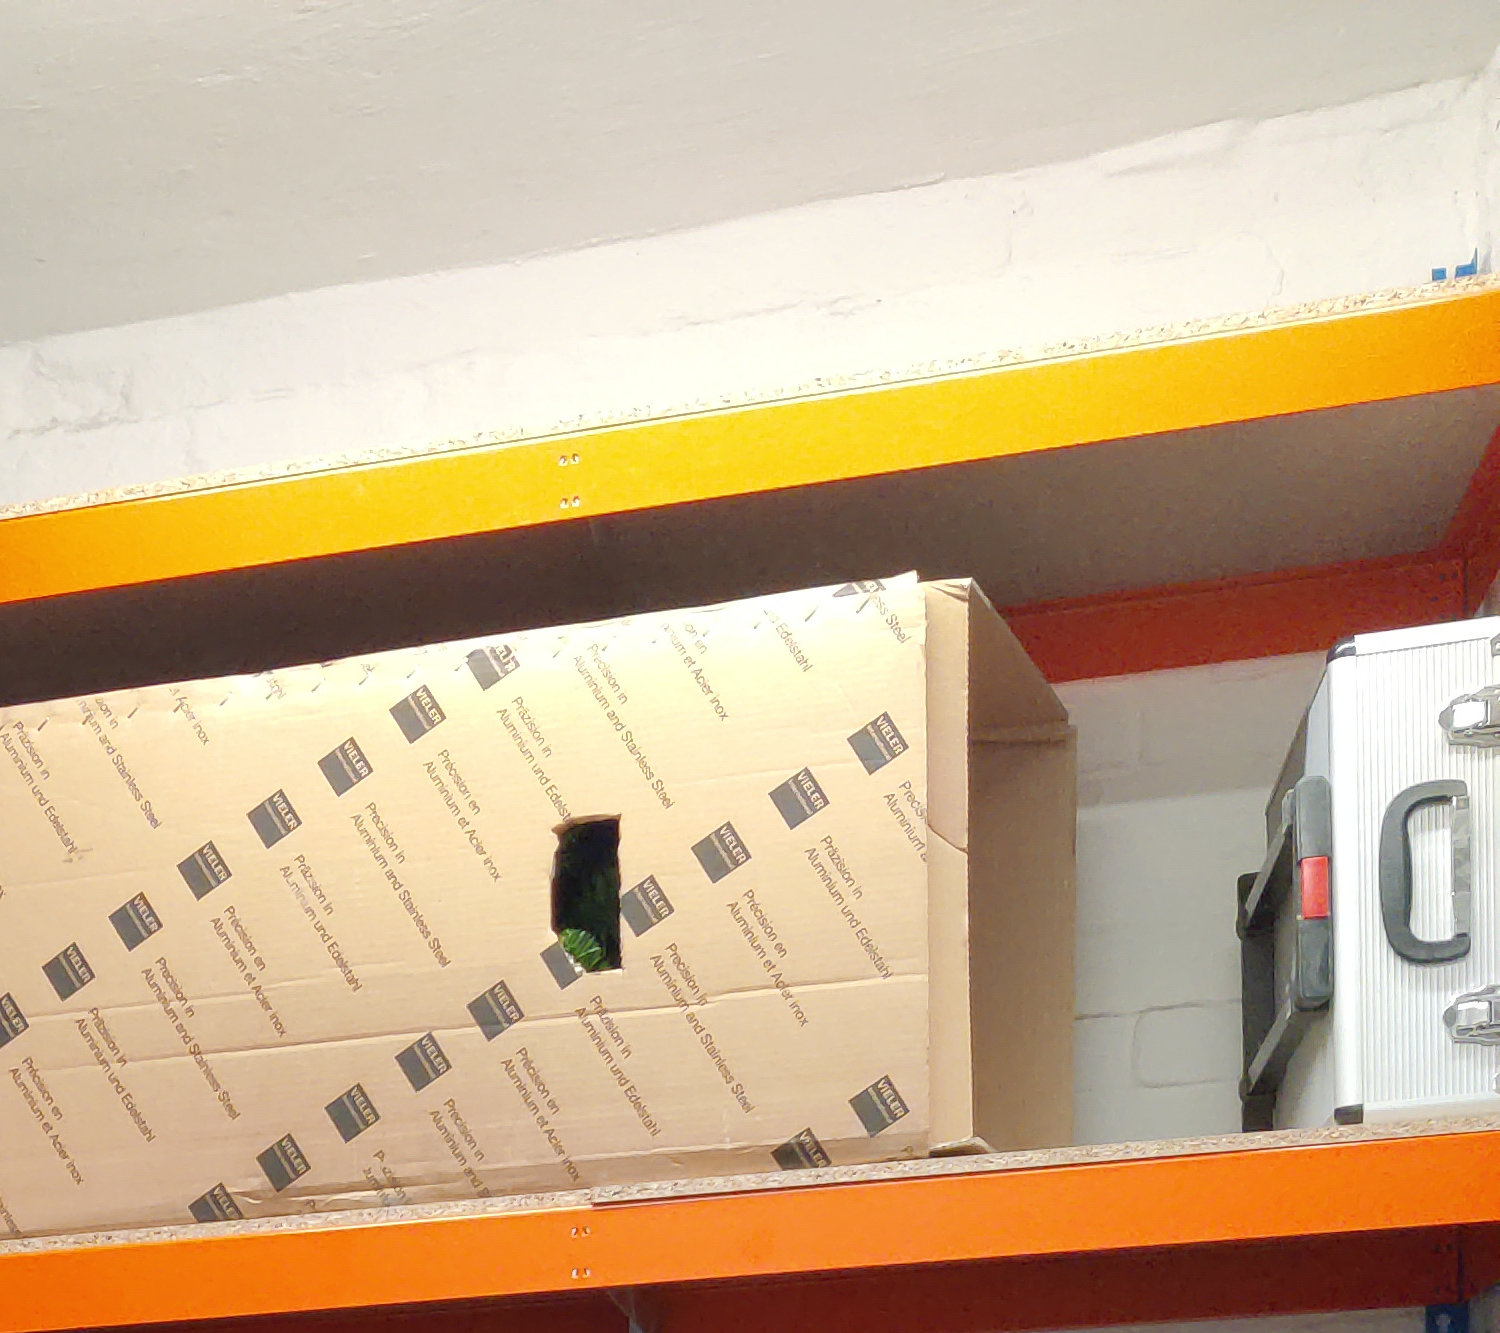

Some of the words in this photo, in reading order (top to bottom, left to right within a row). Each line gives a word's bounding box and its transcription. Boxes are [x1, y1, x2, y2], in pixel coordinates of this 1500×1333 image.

[885, 613, 911, 644] Steel
[415, 687, 441, 724] VIELER
[616, 692, 628, 705] in
[690, 668, 713, 696] Acier
[709, 696, 729, 722] inox
[11, 720, 43, 769] Präzision
[39, 768, 50, 780] in
[343, 740, 368, 777] VIELER
[495, 708, 534, 764] Aluminium
[531, 763, 551, 786] und
[541, 745, 551, 758] in
[572, 655, 610, 710] Aluminium
[606, 710, 626, 732] and
[620, 730, 654, 781] Stainless
[651, 778, 675, 810] Steel
[876, 715, 903, 754] VIELER
[0, 732, 34, 786] Aluminium
[31, 784, 49, 807] und
[43, 805, 77, 854] Edelstahl
[98, 734, 117, 756] and
[111, 753, 143, 802] Stainless
[139, 799, 162, 829] Steel
[272, 793, 297, 830] VIELER
[437, 749, 471, 800] Précision
[467, 799, 480, 815] en
[797, 771, 824, 809] VIELER
[364, 801, 398, 852] Precision
[394, 849, 405, 864] in
[422, 761, 460, 817] Aluminium
[457, 816, 469, 830] et
[463, 829, 486, 856] Acier
[483, 857, 501, 882] inox
[719, 825, 746, 863] VIELER
[882, 793, 925, 851] Aluminium
[202, 844, 227, 881] VIELER
[348, 813, 388, 869] Aluminium
[384, 868, 404, 891] and
[397, 889, 431, 940] Stainless
[427, 937, 451, 968] Steel
[819, 835, 855, 888] Präzision
[851, 885, 862, 900] in
[133, 895, 158, 932] VIELER
[322, 901, 333, 916] in
[643, 879, 669, 917] VIELER
[741, 888, 777, 942] Précision
[773, 942, 787, 958] en
[803, 847, 844, 906] Aluminium
[840, 904, 861, 929] und
[854, 927, 894, 980] Edelstahl
[66, 946, 90, 983] VIELER
[223, 905, 256, 956] Précision
[253, 956, 265, 972] en
[313, 920, 333, 944] und
[326, 940, 362, 992] Edelstahl
[725, 901, 766, 959] Aluminium
[762, 959, 776, 973] et
[769, 972, 794, 1000] Acier
[788, 1000, 808, 1027] inox
[154, 956, 188, 1007] Precision
[183, 1004, 194, 1018] in
[209, 917, 247, 973] Aluminium
[243, 972, 256, 986] et
[250, 984, 272, 1011] Acier
[268, 1011, 286, 1038] inox
[493, 984, 519, 1020] VIELER
[664, 942, 699, 996] Precision
[695, 992, 712, 1006] in
[1, 996, 24, 1033] VIELER
[87, 1006, 120, 1057] Präzision
[115, 1053, 128, 1068] in
[589, 995, 624, 1047] Präzision
[620, 1044, 631, 1059] in
[73, 1018, 111, 1073] Aluminium
[107, 1071, 126, 1095] und
[120, 1092, 156, 1143] Edelstahl
[174, 1022, 194, 1045] and
[188, 1043, 220, 1092] Stainless
[217, 1090, 241, 1120] Steel
[421, 1036, 446, 1073] VIELER
[515, 1047, 550, 1099] Précision
[546, 1098, 559, 1115] en
[572, 1007, 613, 1065] Aluminium
[609, 1063, 630, 1087] und
[623, 1084, 661, 1137] Edelstahl
[685, 1012, 705, 1035] and
[699, 1033, 734, 1084] Stainless
[730, 1083, 755, 1114] Steel
[21, 1056, 53, 1106] Précision
[50, 1105, 63, 1121] en
[350, 1086, 375, 1124] VIELER
[499, 1058, 539, 1116] Aluminium
[535, 1115, 548, 1129] et
[542, 1128, 565, 1156] Acier
[561, 1154, 580, 1182] inox
[877, 1079, 904, 1118] VIELER
[7, 1067, 44, 1122] Aluminium
[41, 1121, 53, 1135] et
[48, 1134, 69, 1160] Acier
[65, 1159, 84, 1185] inox
[281, 1137, 306, 1174] VIELER
[428, 1110, 467, 1166] Aluminium
[462, 1166, 483, 1188] and
[442, 1098, 476, 1150] Precision
[473, 1149, 484, 1162] in
